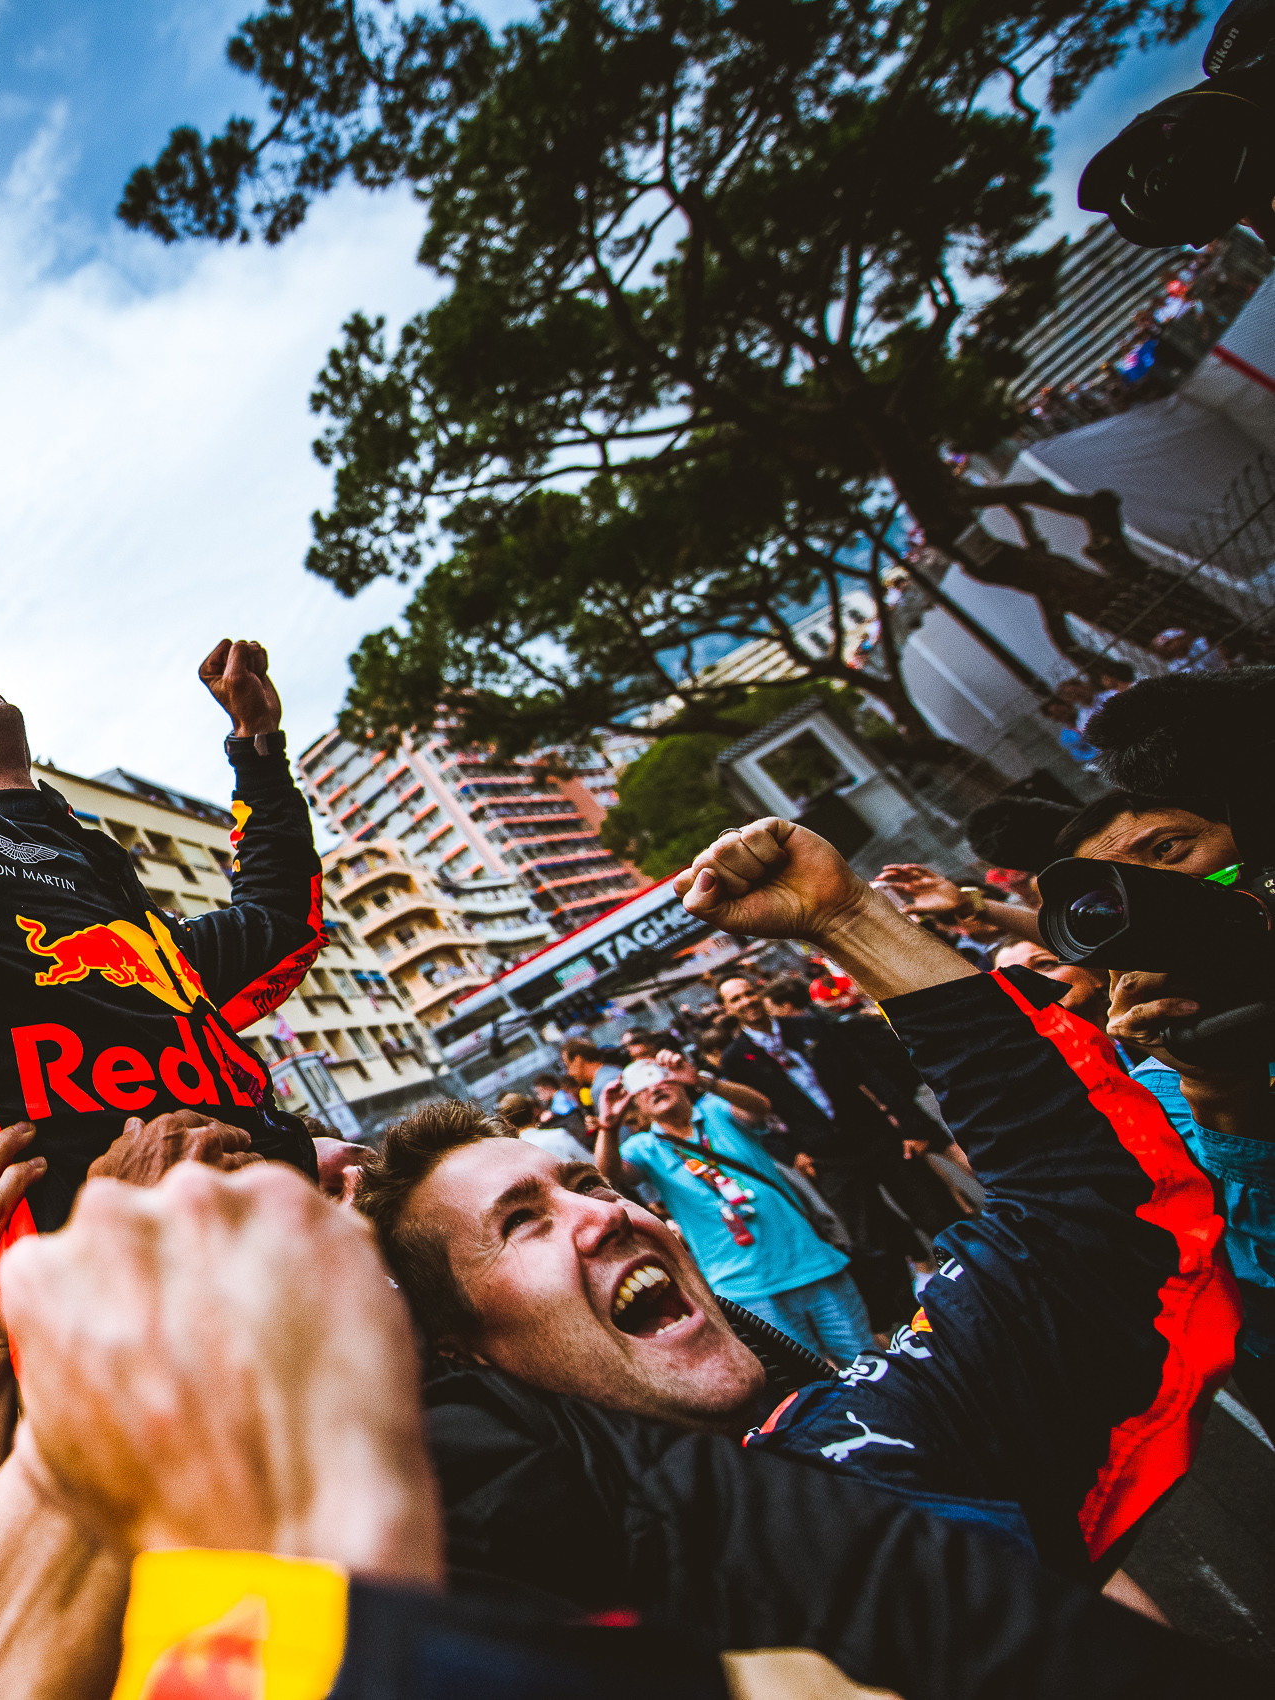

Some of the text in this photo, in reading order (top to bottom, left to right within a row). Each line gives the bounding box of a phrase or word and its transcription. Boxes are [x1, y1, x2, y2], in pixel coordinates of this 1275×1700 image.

[1209, 27, 1239, 73] Nikon
[22, 869, 76, 892] MARTIN
[11, 1016, 221, 1121] Red
